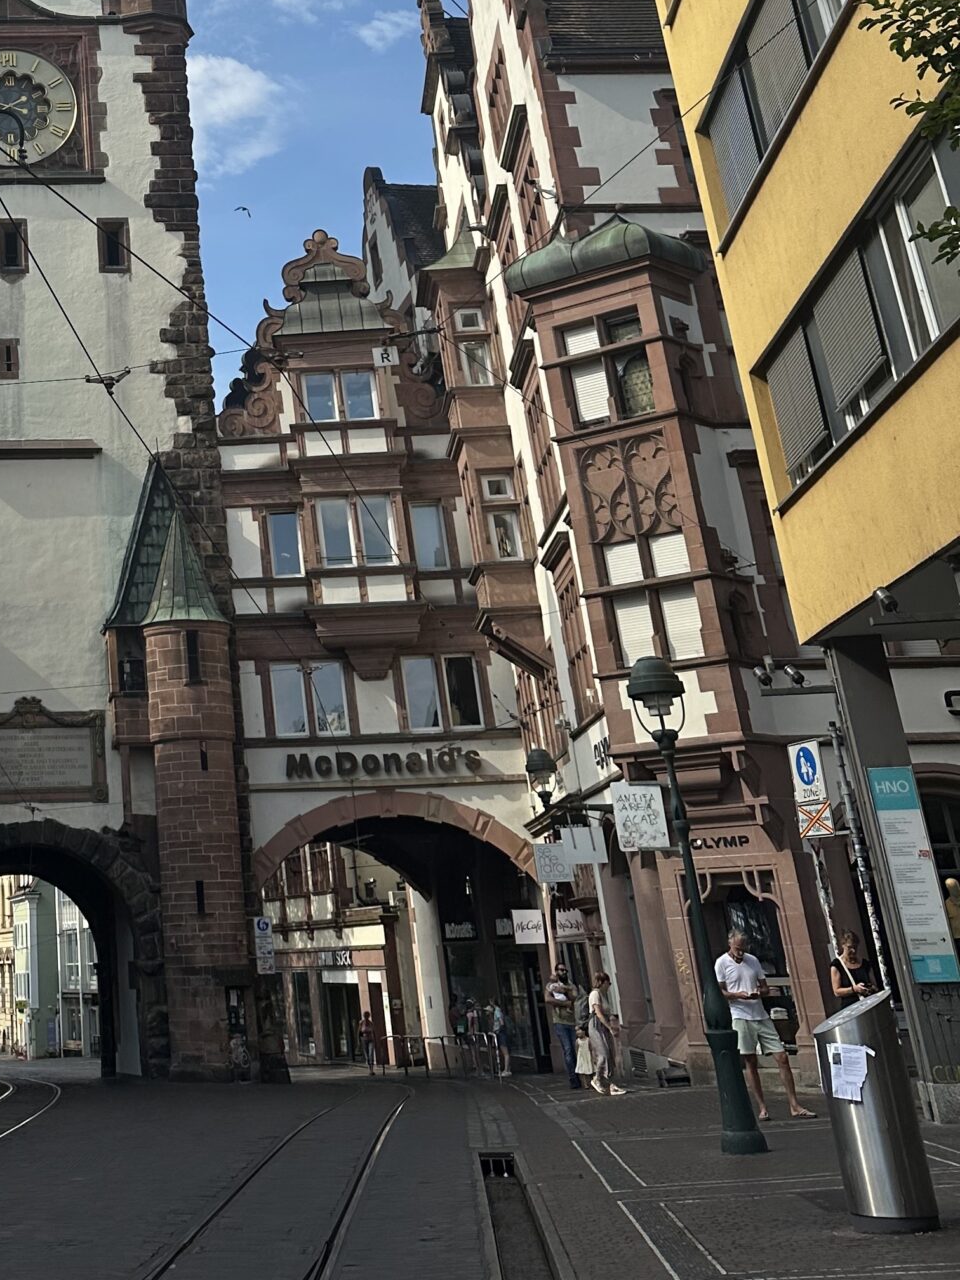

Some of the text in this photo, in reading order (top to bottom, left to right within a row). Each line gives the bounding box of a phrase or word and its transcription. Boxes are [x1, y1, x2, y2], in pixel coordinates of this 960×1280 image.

[381, 352, 391, 363] R
[286, 746, 482, 778] McDonald's
[874, 780, 909, 793] HNO
[616, 793, 656, 804] ANTIFA
[619, 802, 653, 812] AREA
[624, 813, 658, 826] ACAB
[691, 835, 750, 849] OLYMP
